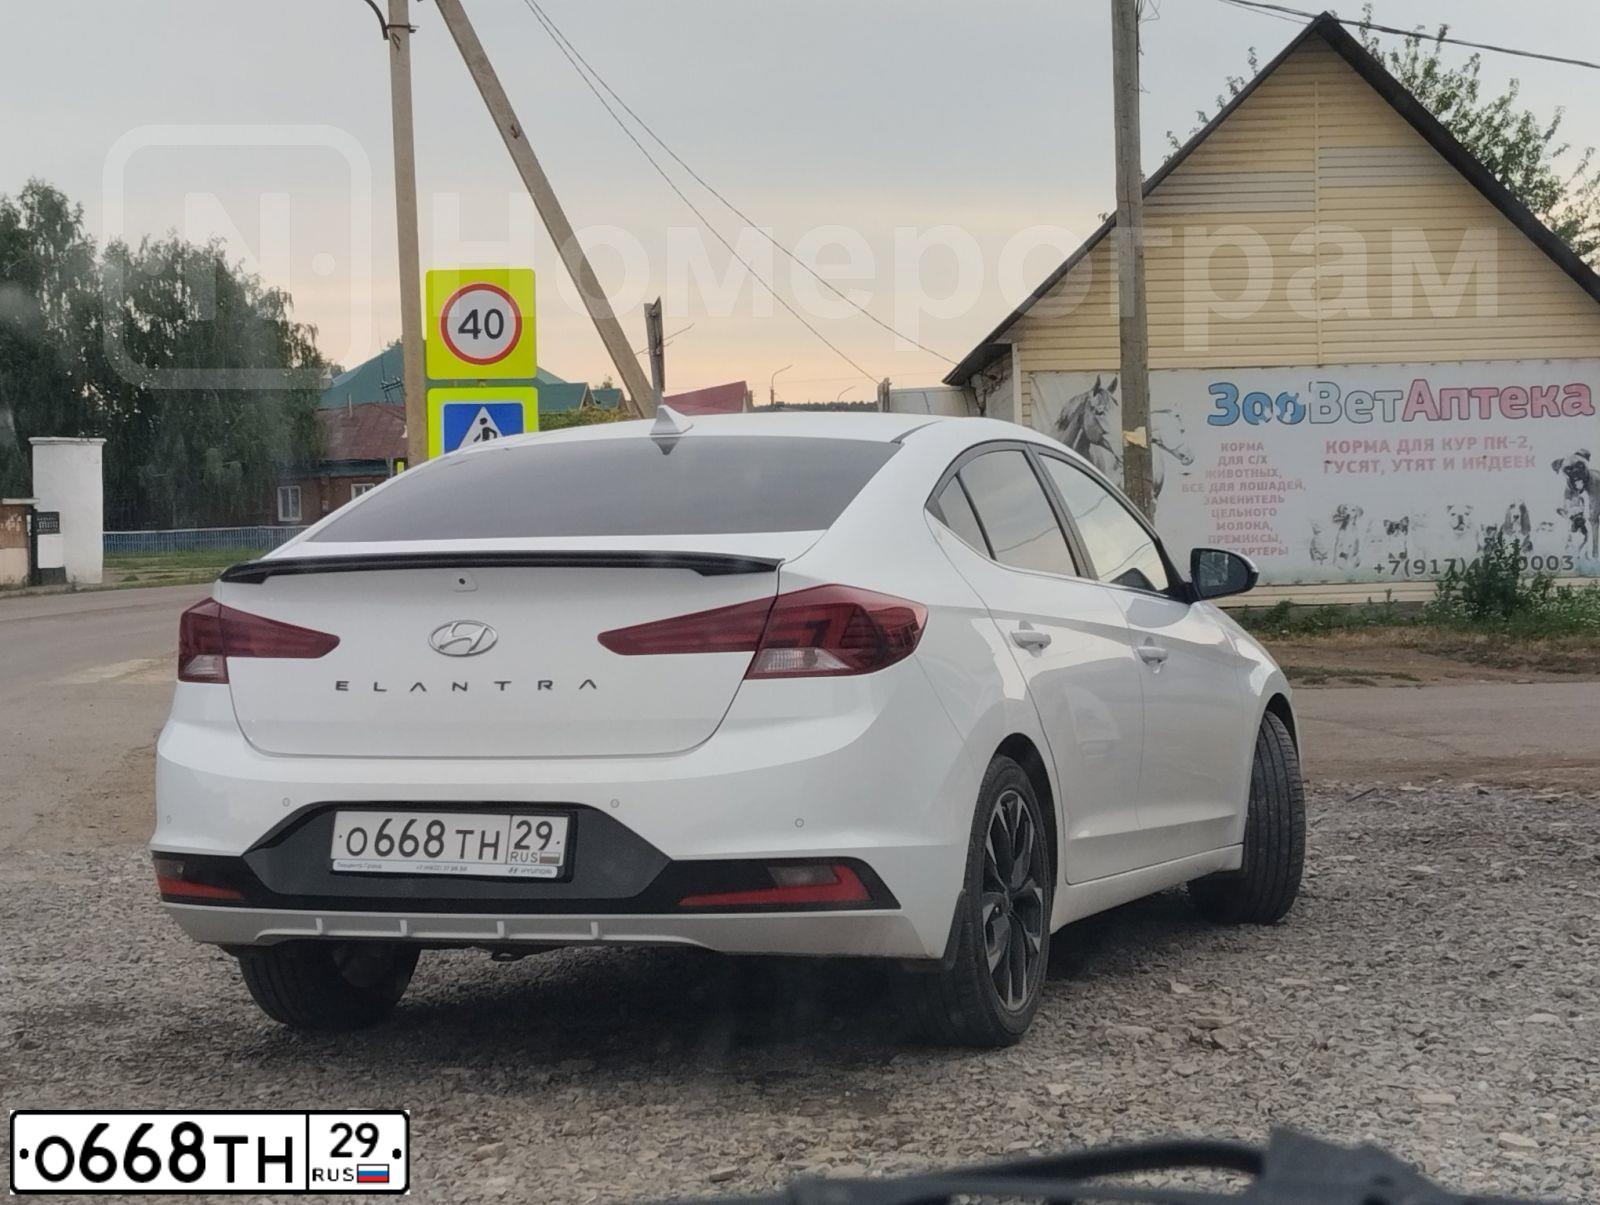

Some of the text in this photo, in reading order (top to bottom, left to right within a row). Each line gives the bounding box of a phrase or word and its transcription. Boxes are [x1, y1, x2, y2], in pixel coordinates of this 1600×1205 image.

[458, 308, 505, 340] 40
[1220, 442, 1264, 453] КОРМА
[1326, 436, 1534, 455] КОРМА ДЛЯ КУР ПК-2,
[1218, 454, 1268, 467] ДЛЯ С/Х
[1324, 455, 1536, 475] ГУСЯТ, УТЯТ И ИНДЕЕК
[1205, 468, 1282, 479] ЖИВОТНЫХ,
[1209, 482, 1235, 493] ДЛЯ
[1203, 495, 1285, 506] ЗАМЕНИТЕЛЬ
[1211, 508, 1278, 519] ЦЕЛЬНОГО
[1216, 521, 1273, 532] МОЛОКА,
[1208, 534, 1283, 545] ПРЕМИКСЫ,
[1226, 546, 1289, 557] АРТЕРЫ
[335, 679, 597, 692] ELANTRA
[513, 820, 554, 851] 29
[510, 851, 538, 863] RUS
